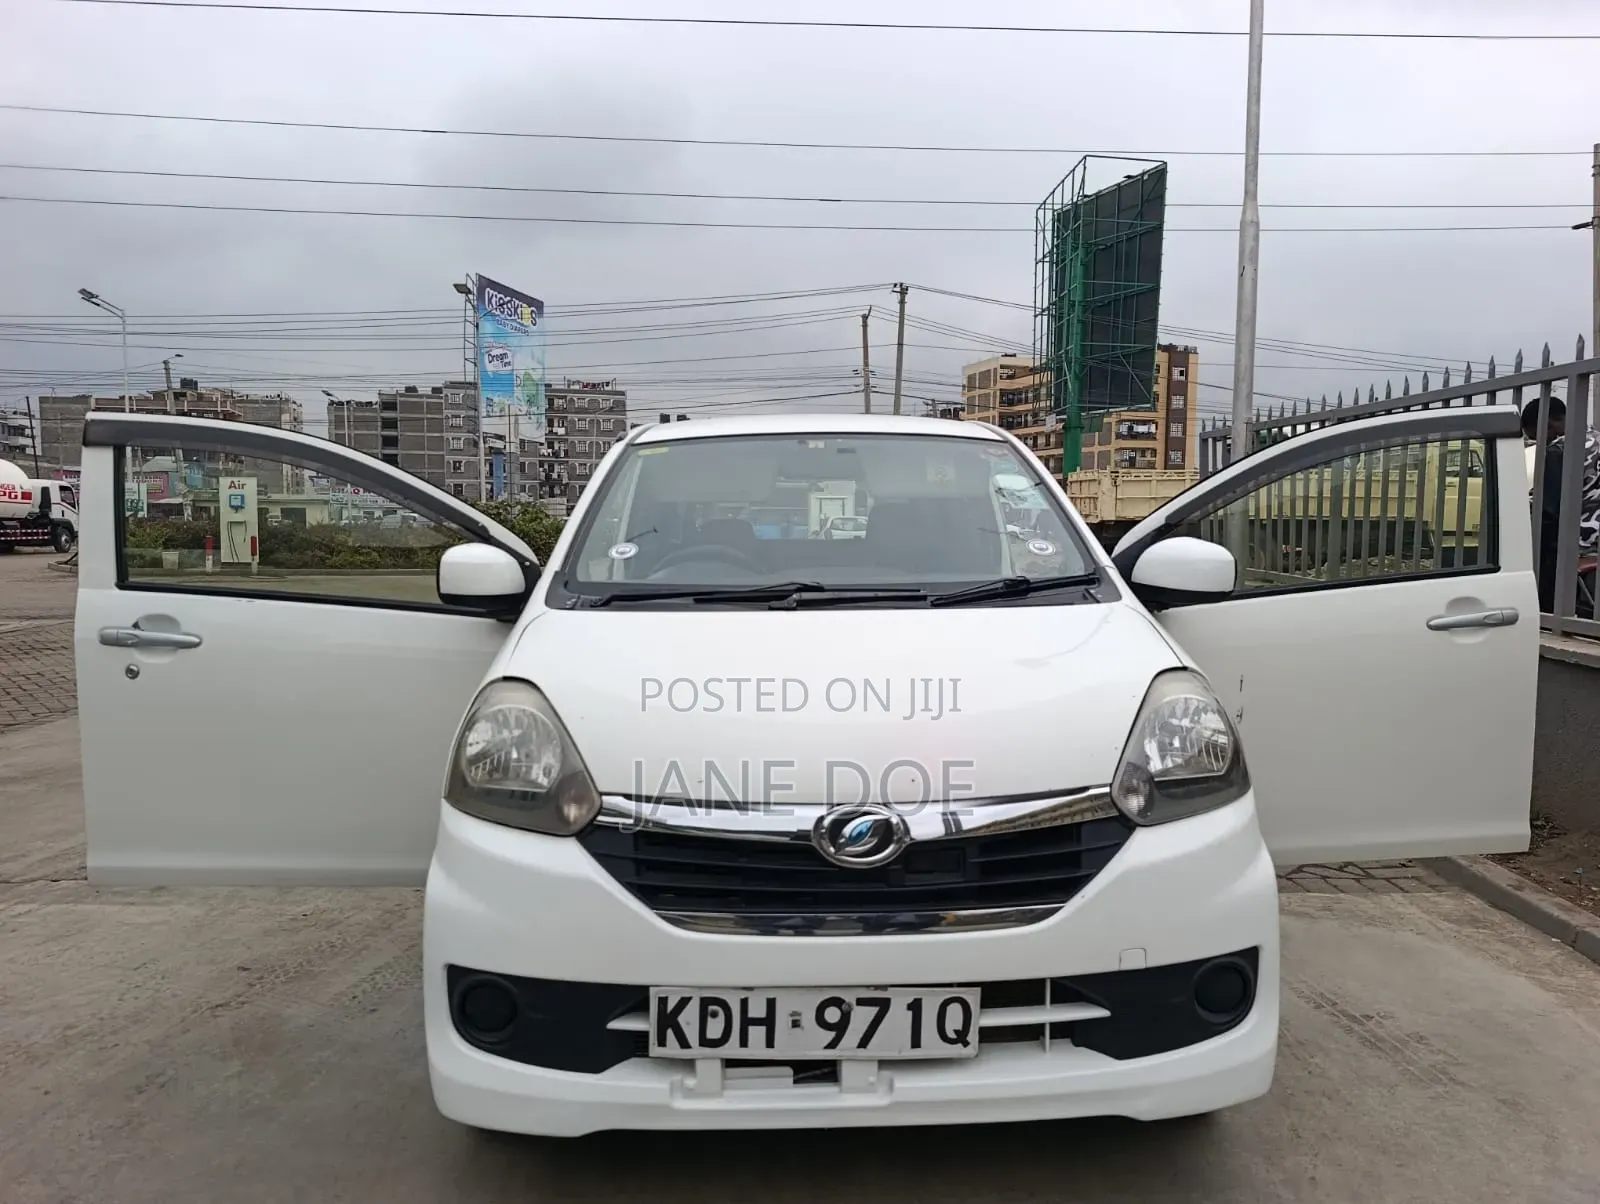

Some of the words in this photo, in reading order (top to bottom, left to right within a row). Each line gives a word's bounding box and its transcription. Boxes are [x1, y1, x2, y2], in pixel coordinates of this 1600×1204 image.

[488, 352, 508, 364] Dream
[228, 480, 247, 490] Air
[656, 996, 777, 1049] KDH
[815, 995, 973, 1050] 971Q
